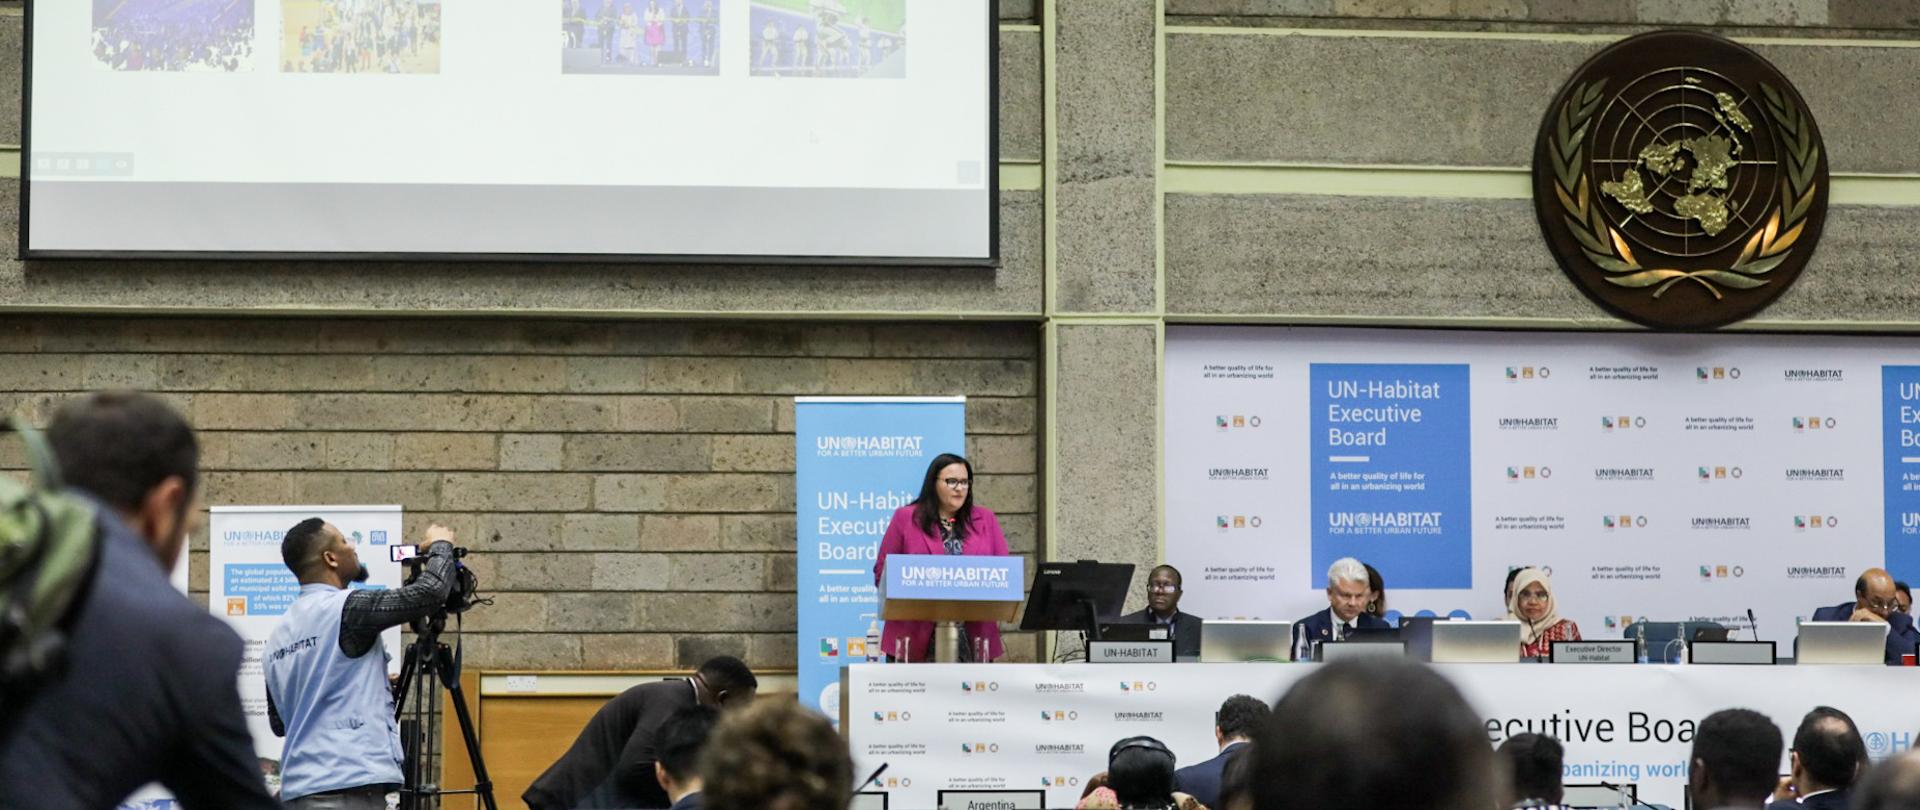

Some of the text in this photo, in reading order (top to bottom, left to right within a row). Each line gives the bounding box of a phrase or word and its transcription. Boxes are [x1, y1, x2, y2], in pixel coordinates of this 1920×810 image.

[1328, 380, 1440, 399] UN-Habitat
[1329, 404, 1421, 422] Executive
[858, 437, 923, 450] HABITAT
[1329, 428, 1386, 446] Board
[1362, 472, 1388, 481] quality
[1362, 483, 1401, 492] urbanizing
[818, 491, 914, 510] UN-Habit
[818, 516, 890, 535] Executi
[1372, 513, 1442, 526] HABITAT
[255, 531, 284, 540] HABI
[819, 542, 877, 561] Board
[943, 567, 1008, 580] HABITAT
[1104, 648, 1157, 657] UN-HABITAT
[1485, 710, 1696, 742] ecutive Boa
[1646, 762, 1688, 777] worl
